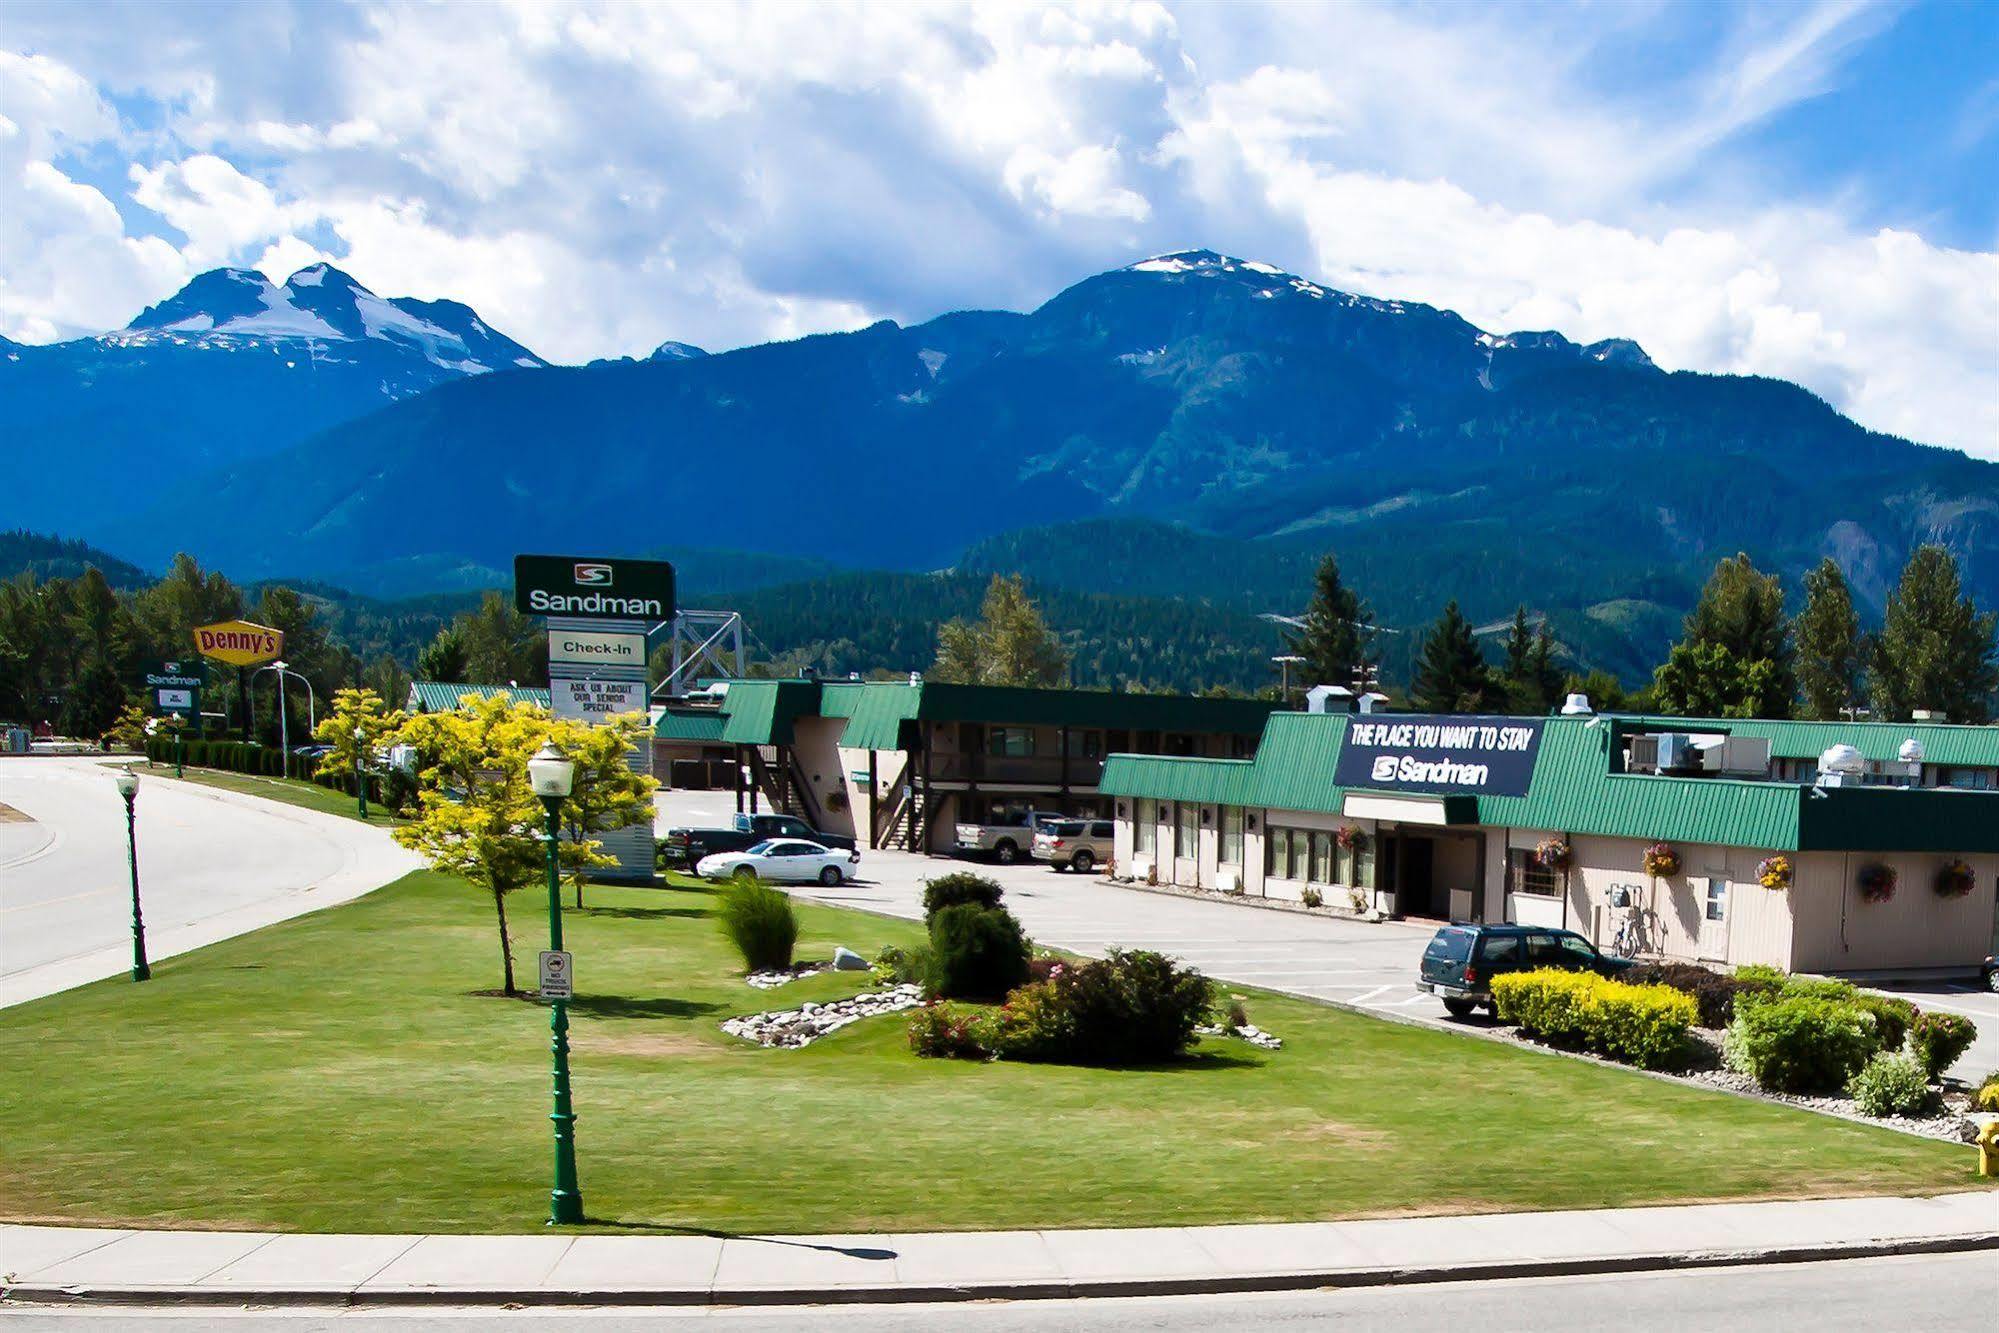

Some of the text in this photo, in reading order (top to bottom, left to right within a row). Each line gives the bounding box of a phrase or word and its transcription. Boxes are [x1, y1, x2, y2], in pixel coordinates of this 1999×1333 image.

[530, 589, 661, 615] Sandman
[200, 630, 275, 654] Denny's
[563, 641, 632, 655] Check-In
[146, 673, 201, 686] Sandman
[570, 683, 632, 694] ASK US ABOUT
[574, 693, 626, 704] OUR SENIOR
[583, 703, 614, 713] SPECIAL
[1351, 724, 1534, 751] THE PLACE YOU WANT TO STAY
[1398, 755, 1488, 786] Sandman
